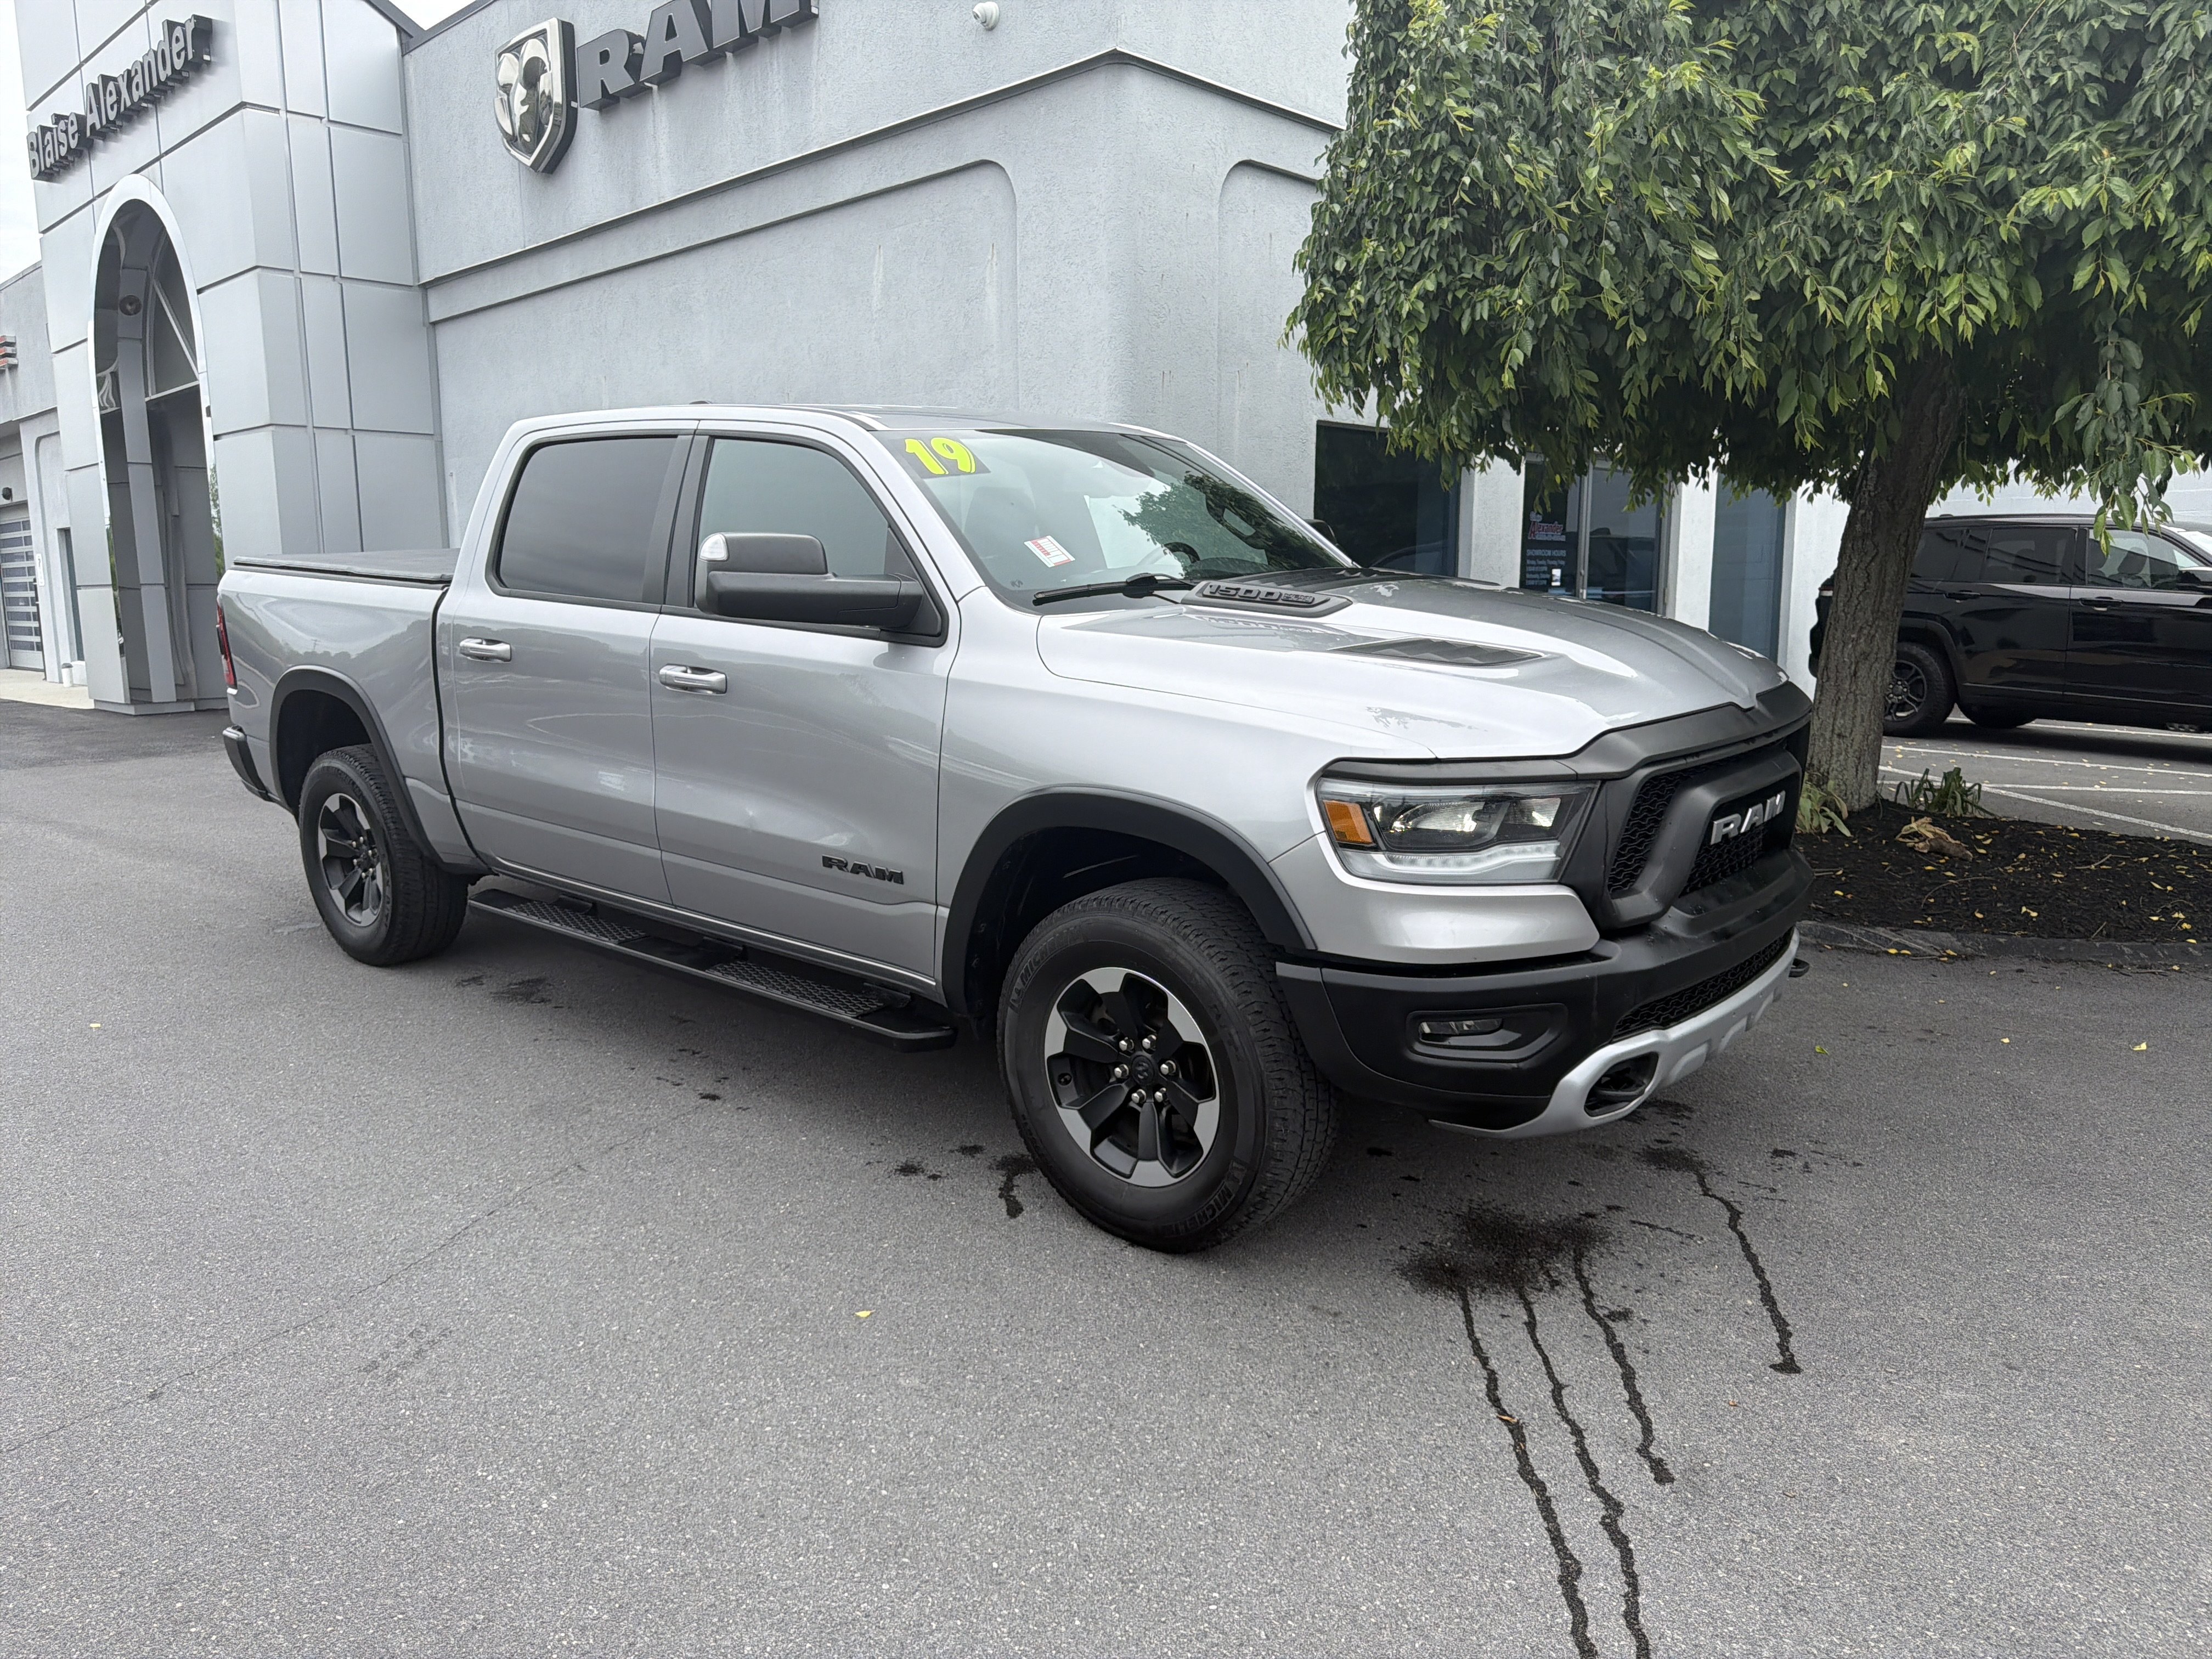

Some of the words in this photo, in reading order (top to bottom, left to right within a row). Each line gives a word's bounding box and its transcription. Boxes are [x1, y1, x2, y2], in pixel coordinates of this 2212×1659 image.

[26, 111, 79, 180] Blaise
[86, 14, 196, 138] Alexander
[905, 437, 976, 475] 19
[1209, 584, 1283, 601] 1500
[1710, 790, 1786, 845] RAM
[822, 854, 904, 885] RAM
